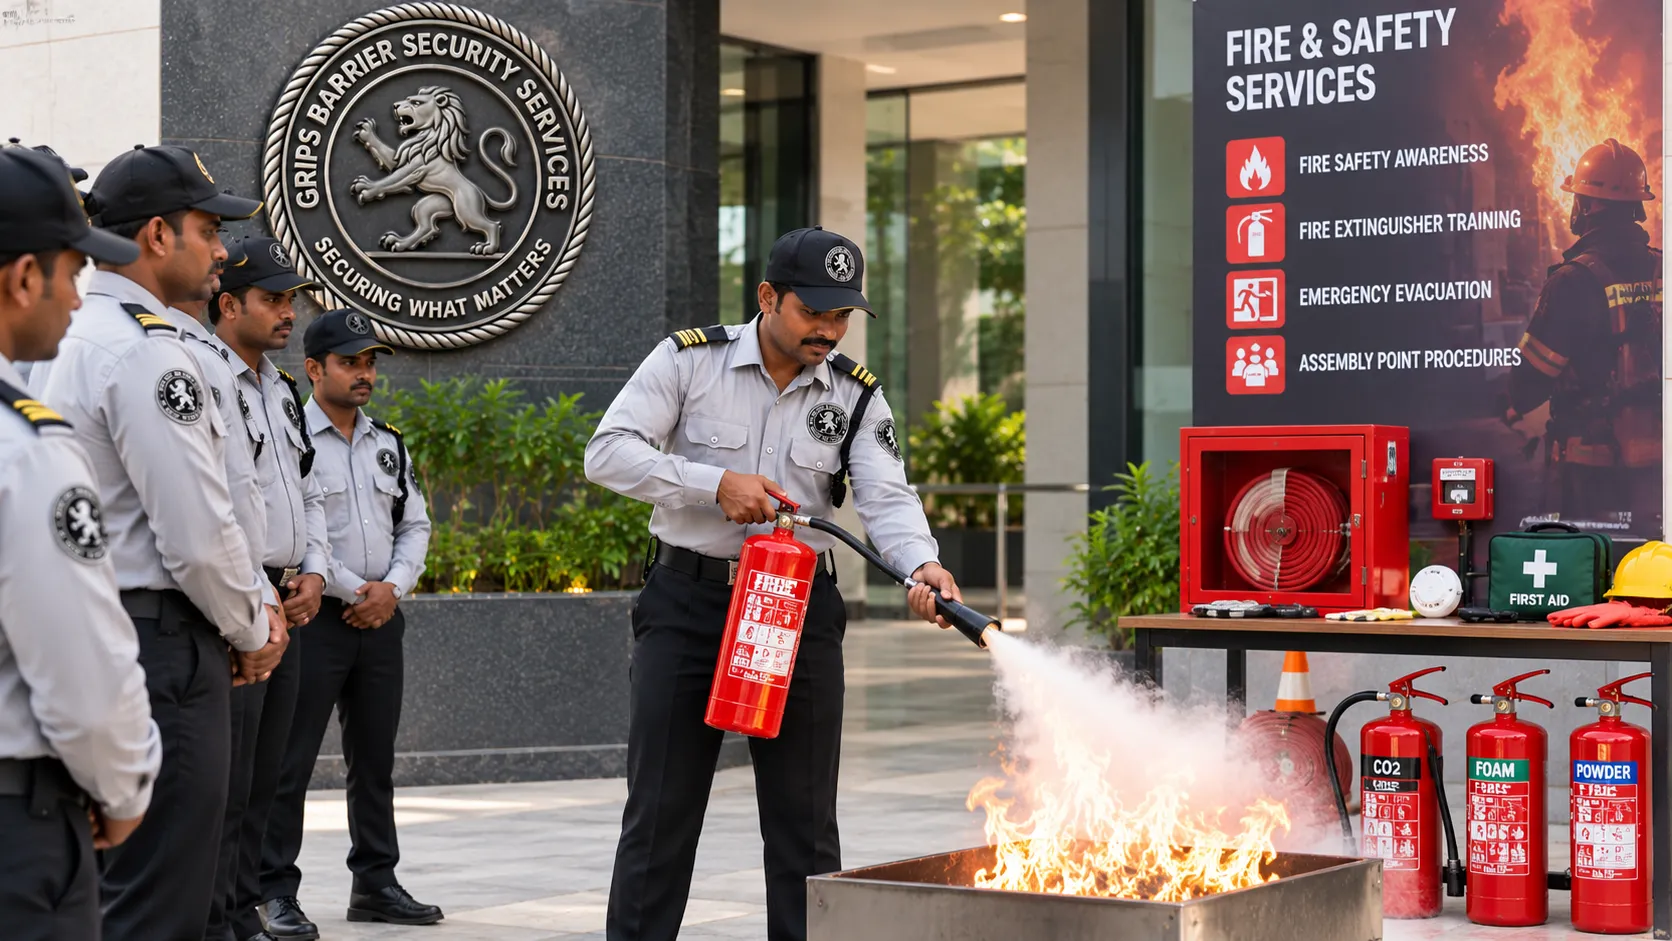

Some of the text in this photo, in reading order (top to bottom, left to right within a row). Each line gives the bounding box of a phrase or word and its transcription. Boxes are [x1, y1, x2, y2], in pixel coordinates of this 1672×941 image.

[1226, 8, 1456, 66] FIRE & SAFETY
[1226, 64, 1375, 112] SERVICES
[294, 32, 570, 211] GRIPS BARRIER SECURITY SERVICES
[1300, 143, 1488, 174] FIRE SAFETY AWARENESS
[1300, 209, 1521, 239] FIRE EXTINGUISHER TRAINING
[314, 237, 552, 319] SECURING WHAT MATTERS
[1300, 280, 1492, 306] EMERGENCY EVACUATION
[1299, 348, 1521, 372] ASSEMBLY POINT PROCEDURES
[1510, 593, 1569, 606] FIRST AID
[1373, 759, 1401, 776] CO2
[1475, 761, 1515, 778] FOAM
[1577, 764, 1631, 779] POWDER
